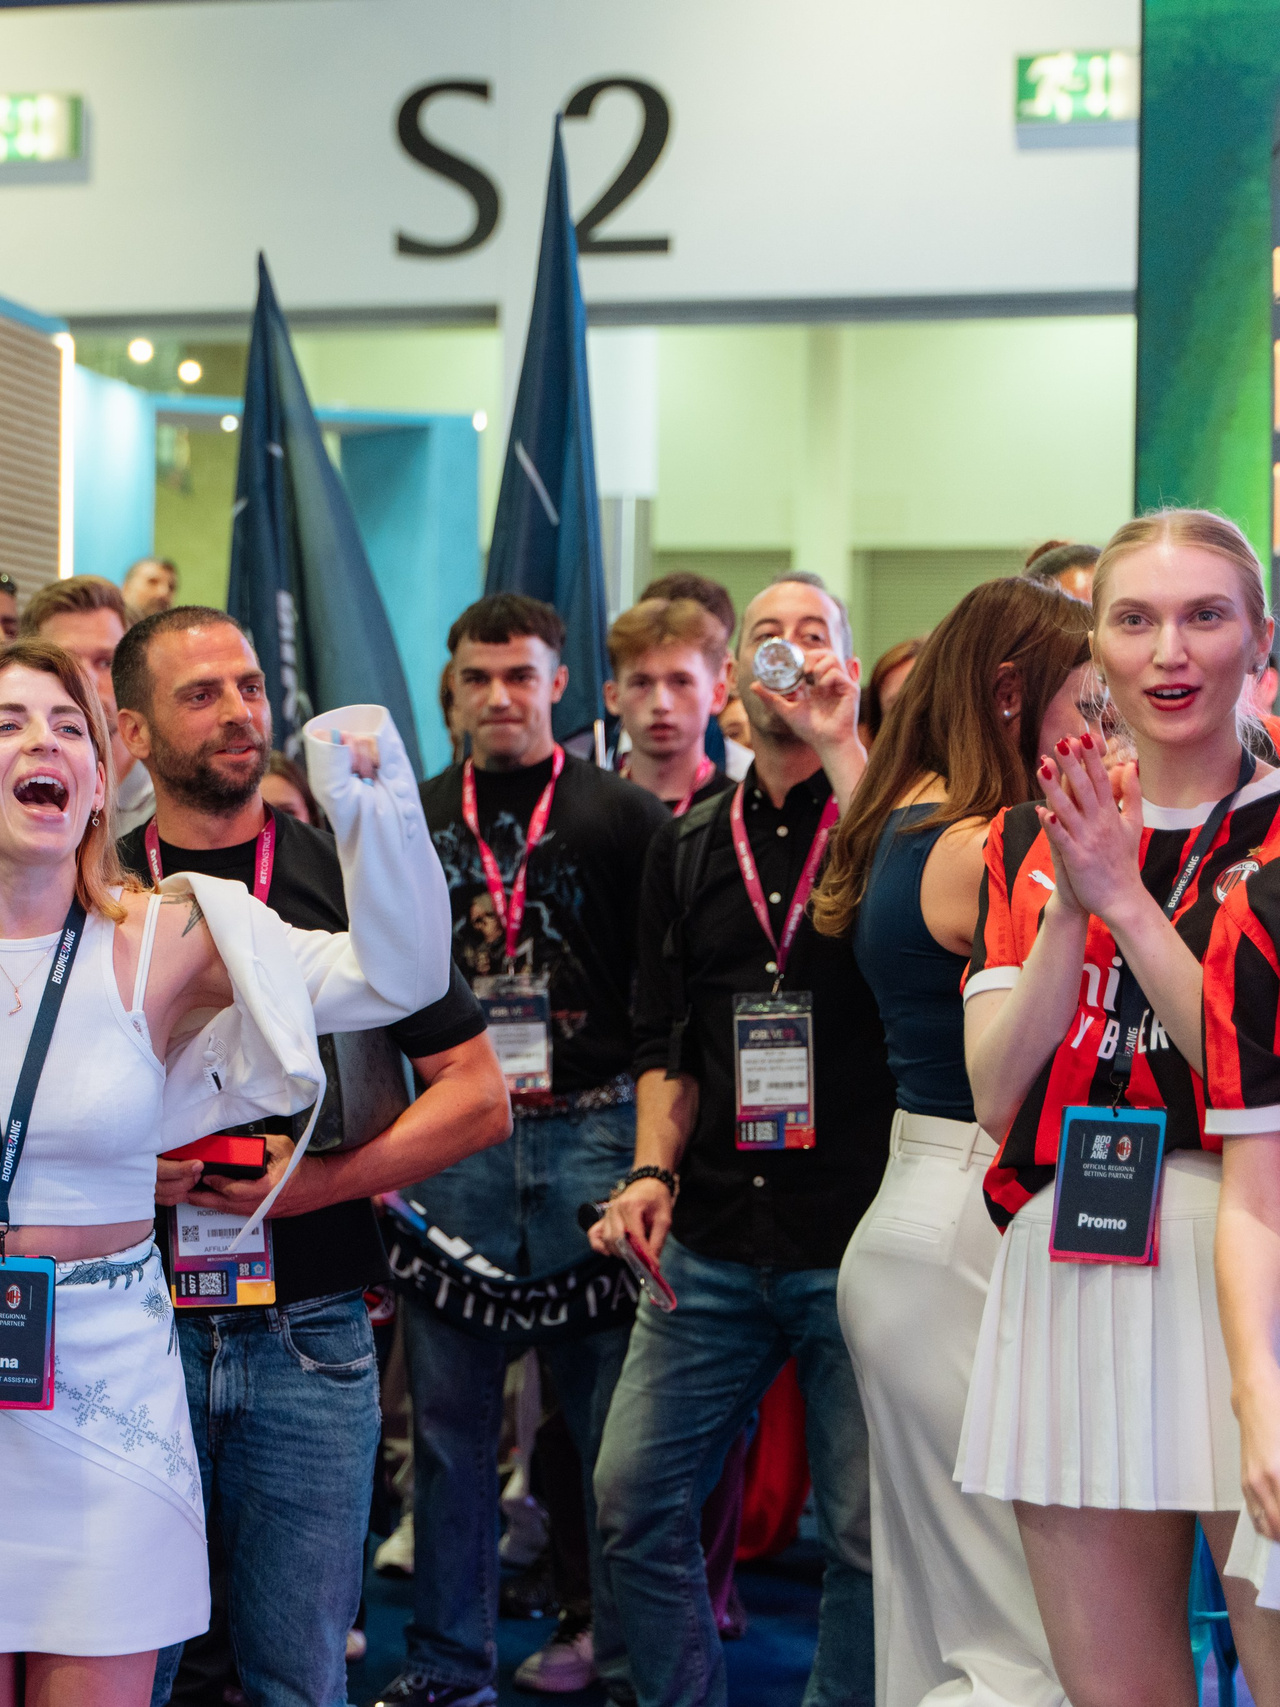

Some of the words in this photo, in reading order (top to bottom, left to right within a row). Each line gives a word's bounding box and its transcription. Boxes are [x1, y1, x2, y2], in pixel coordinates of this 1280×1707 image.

[260, 831, 271, 885] BETCONSTRUCT
[1090, 1150, 1108, 1160] ANG
[1082, 1163, 1107, 1171] OFFICIAL
[1107, 1164, 1136, 1172] REGIONAL
[1077, 1212, 1127, 1230] Promo
[4, 1376, 38, 1384] ASSISTANT
